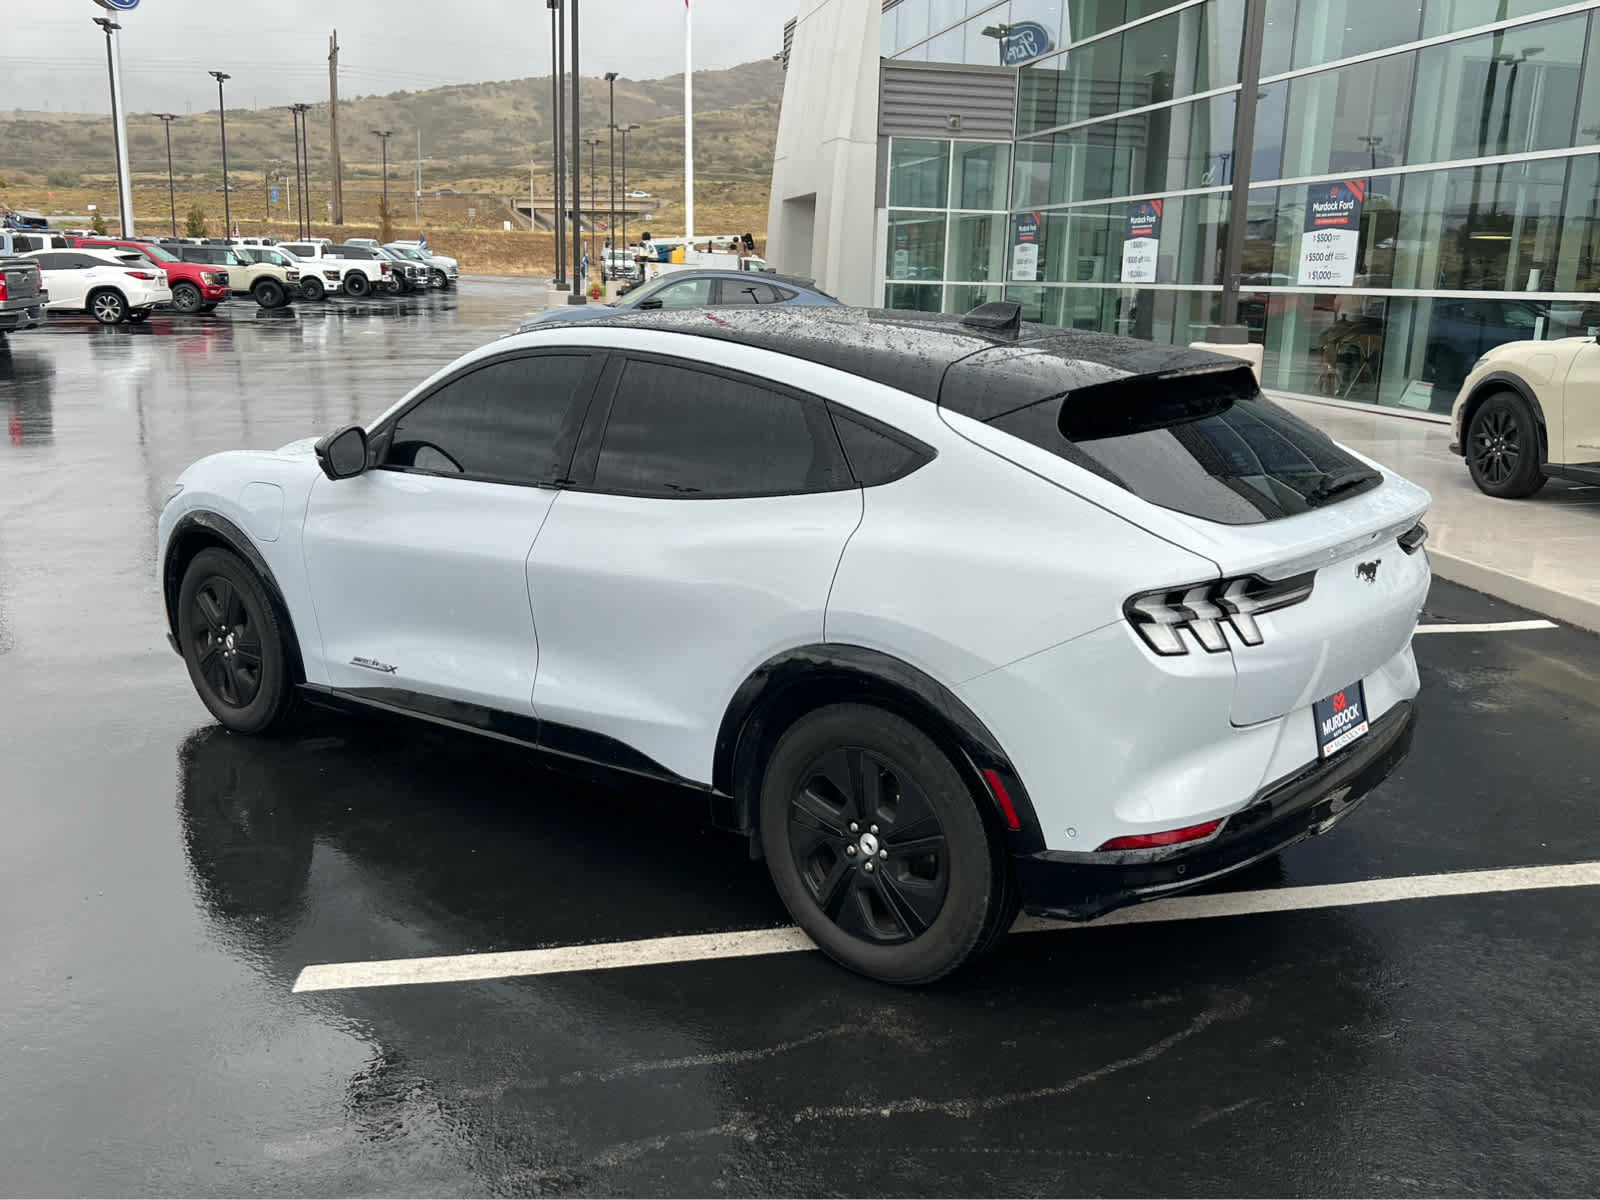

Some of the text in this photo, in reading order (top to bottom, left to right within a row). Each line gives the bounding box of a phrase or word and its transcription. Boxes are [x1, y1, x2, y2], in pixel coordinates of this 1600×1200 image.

[1313, 200, 1354, 212] Murdock Ford
[1317, 233, 1332, 242] $500
[1308, 252, 1324, 262] $500
[1324, 251, 1334, 261] off
[1322, 703, 1360, 736] MURDOCK
